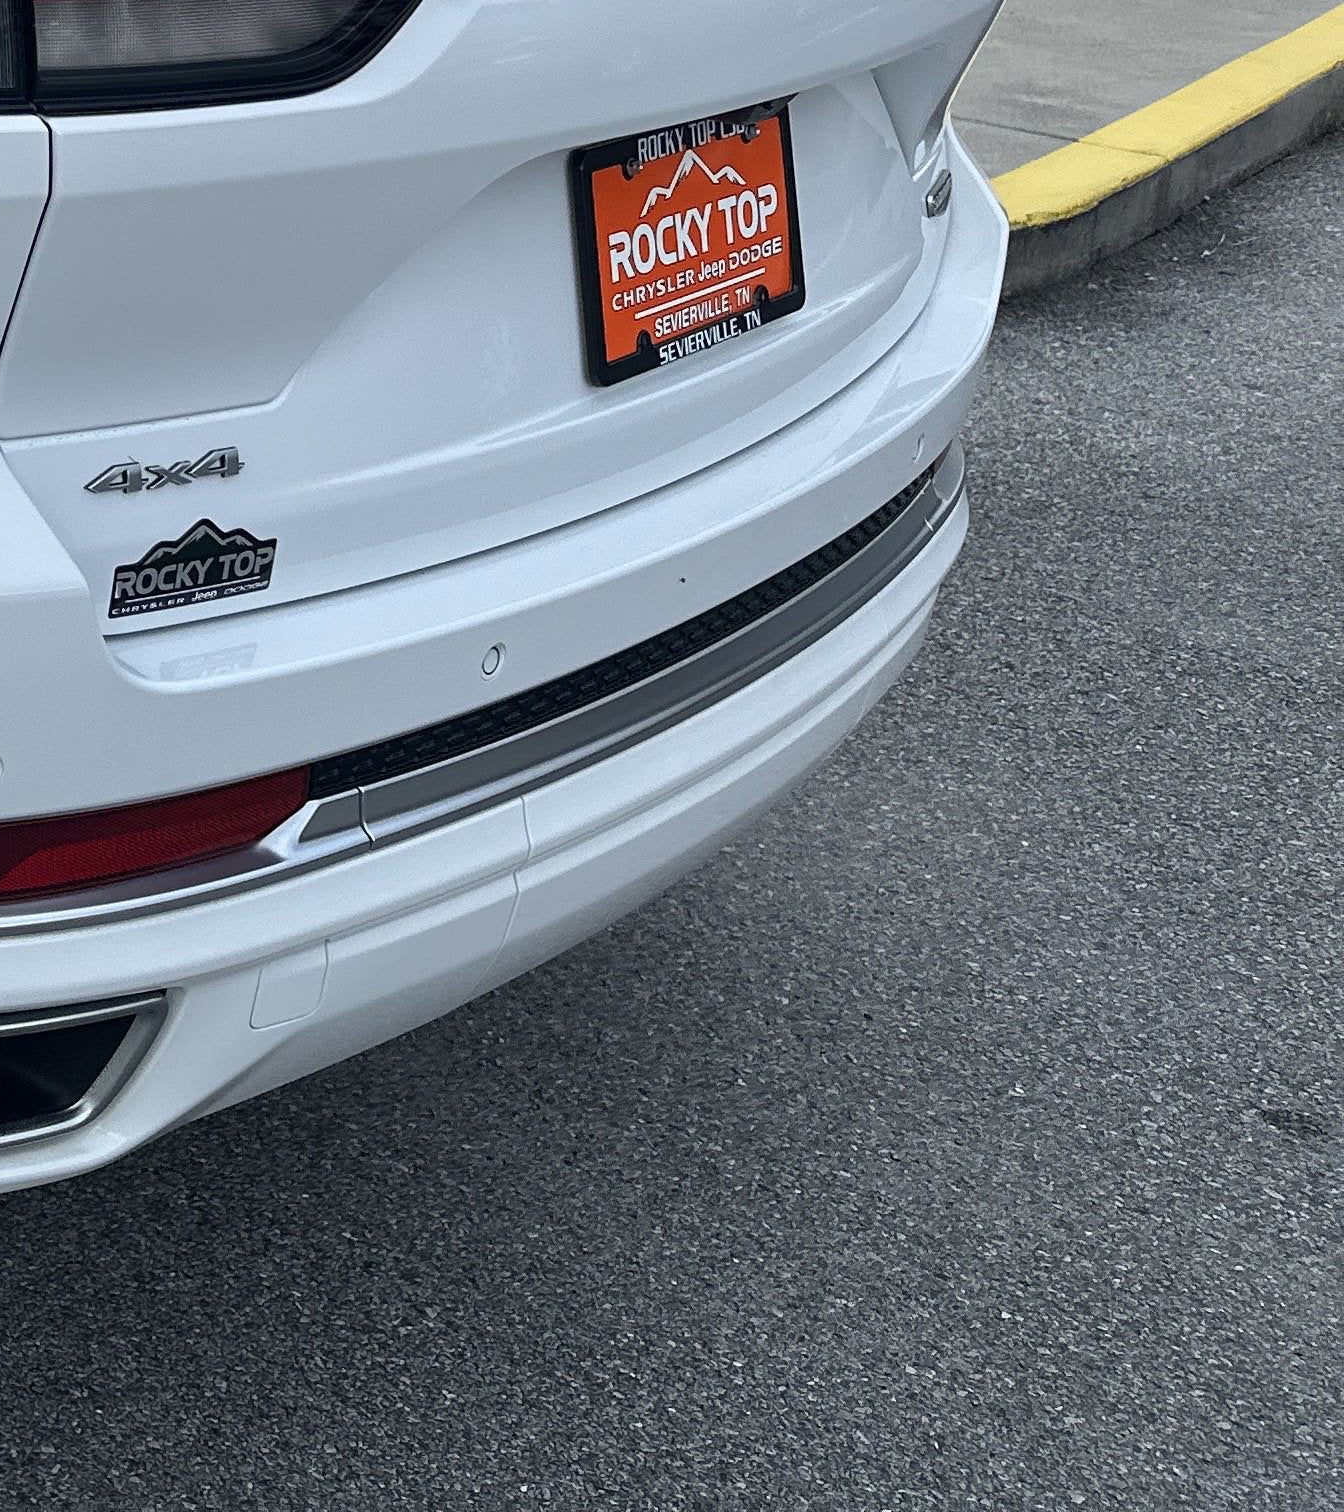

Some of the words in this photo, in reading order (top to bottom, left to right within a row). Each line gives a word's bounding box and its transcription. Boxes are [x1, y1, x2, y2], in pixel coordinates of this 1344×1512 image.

[638, 126, 685, 163] ROCKY
[688, 120, 716, 147] TOP
[609, 203, 712, 283] ROCKY
[718, 183, 778, 244] TOP
[612, 270, 695, 311] CHRYSLER
[697, 259, 726, 282] Jeep
[729, 236, 782, 271] DODGE
[654, 294, 733, 337] SEVIERVILLE,
[735, 286, 751, 305] TN
[659, 318, 742, 365] SEVIERVILLE,
[744, 309, 761, 330] TN
[84, 446, 245, 494] 4x4
[114, 557, 214, 599] ROCKY
[218, 546, 274, 580] TOP
[112, 597, 185, 615] CHRYSLER
[192, 590, 217, 602] Jeep
